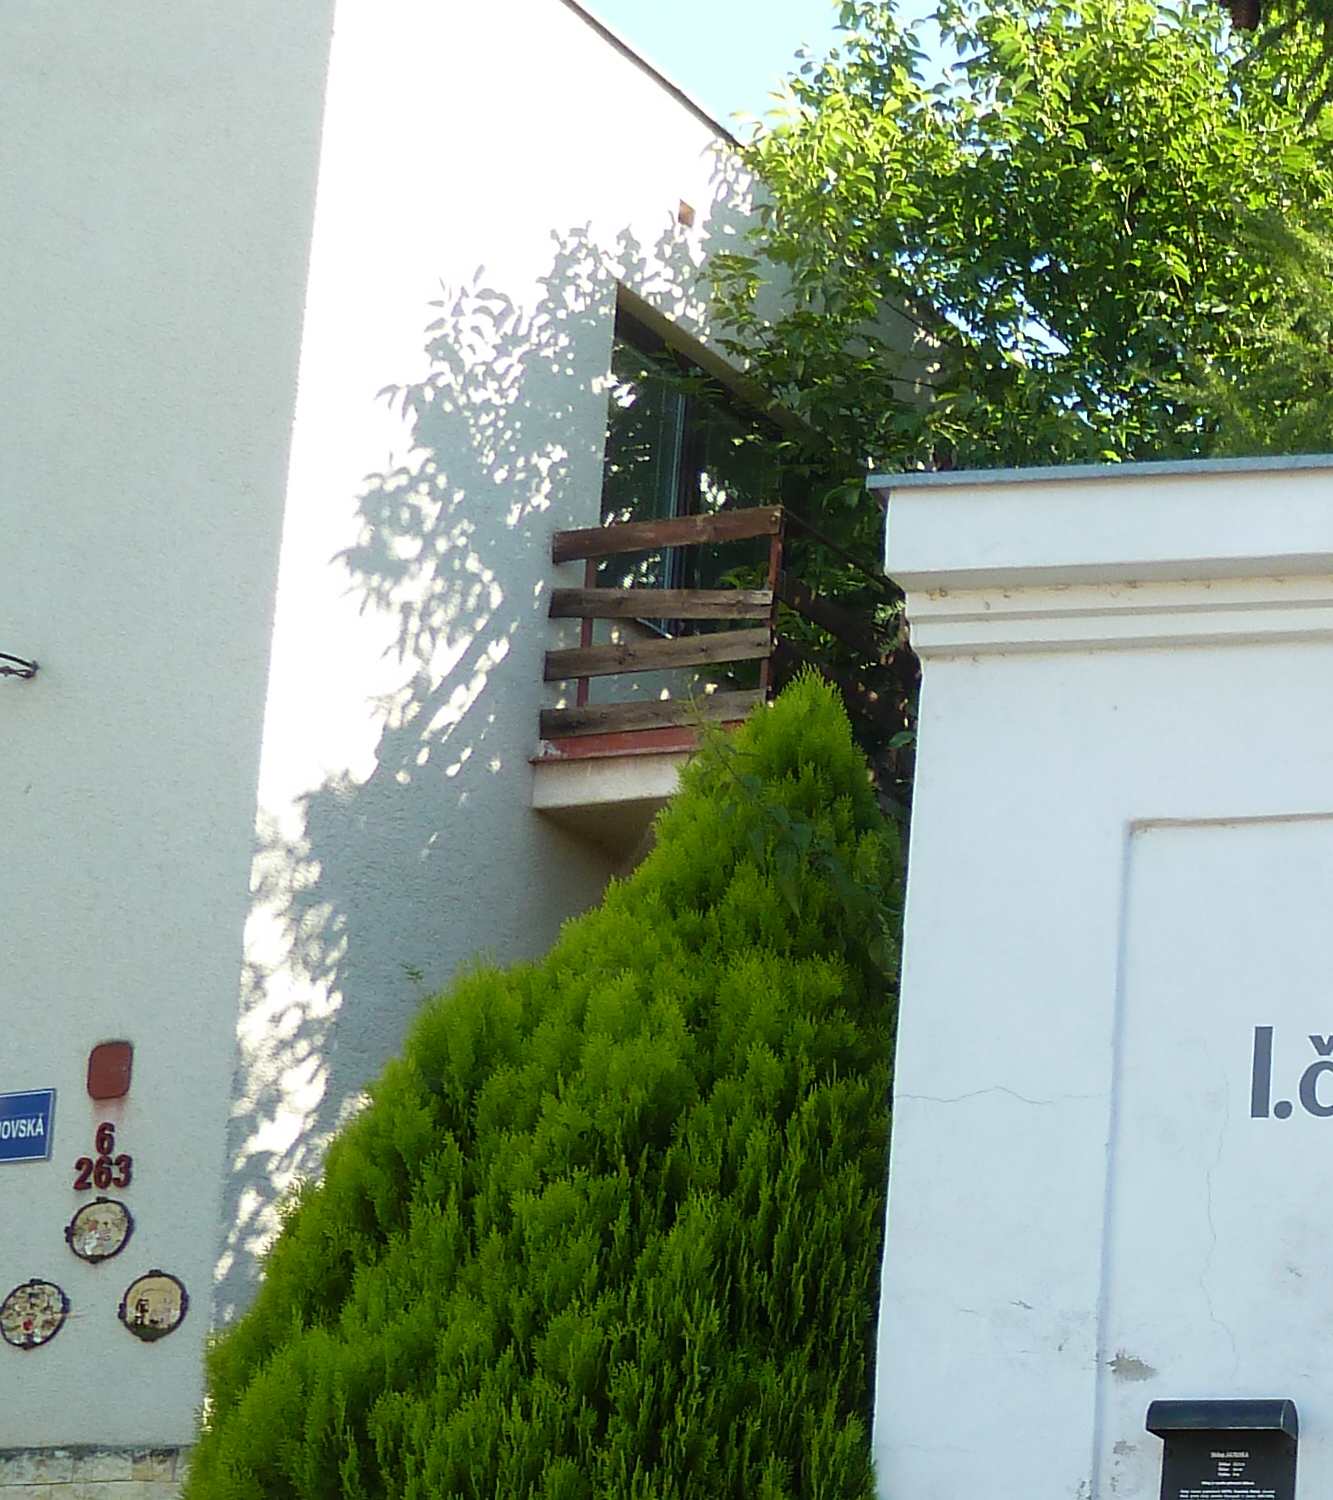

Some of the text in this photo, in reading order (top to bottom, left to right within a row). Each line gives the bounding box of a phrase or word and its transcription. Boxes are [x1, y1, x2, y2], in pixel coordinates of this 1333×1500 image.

[0, 1112, 44, 1139] OVSKÁ
[96, 1122, 115, 1154] 6
[74, 1154, 133, 1190] 263
